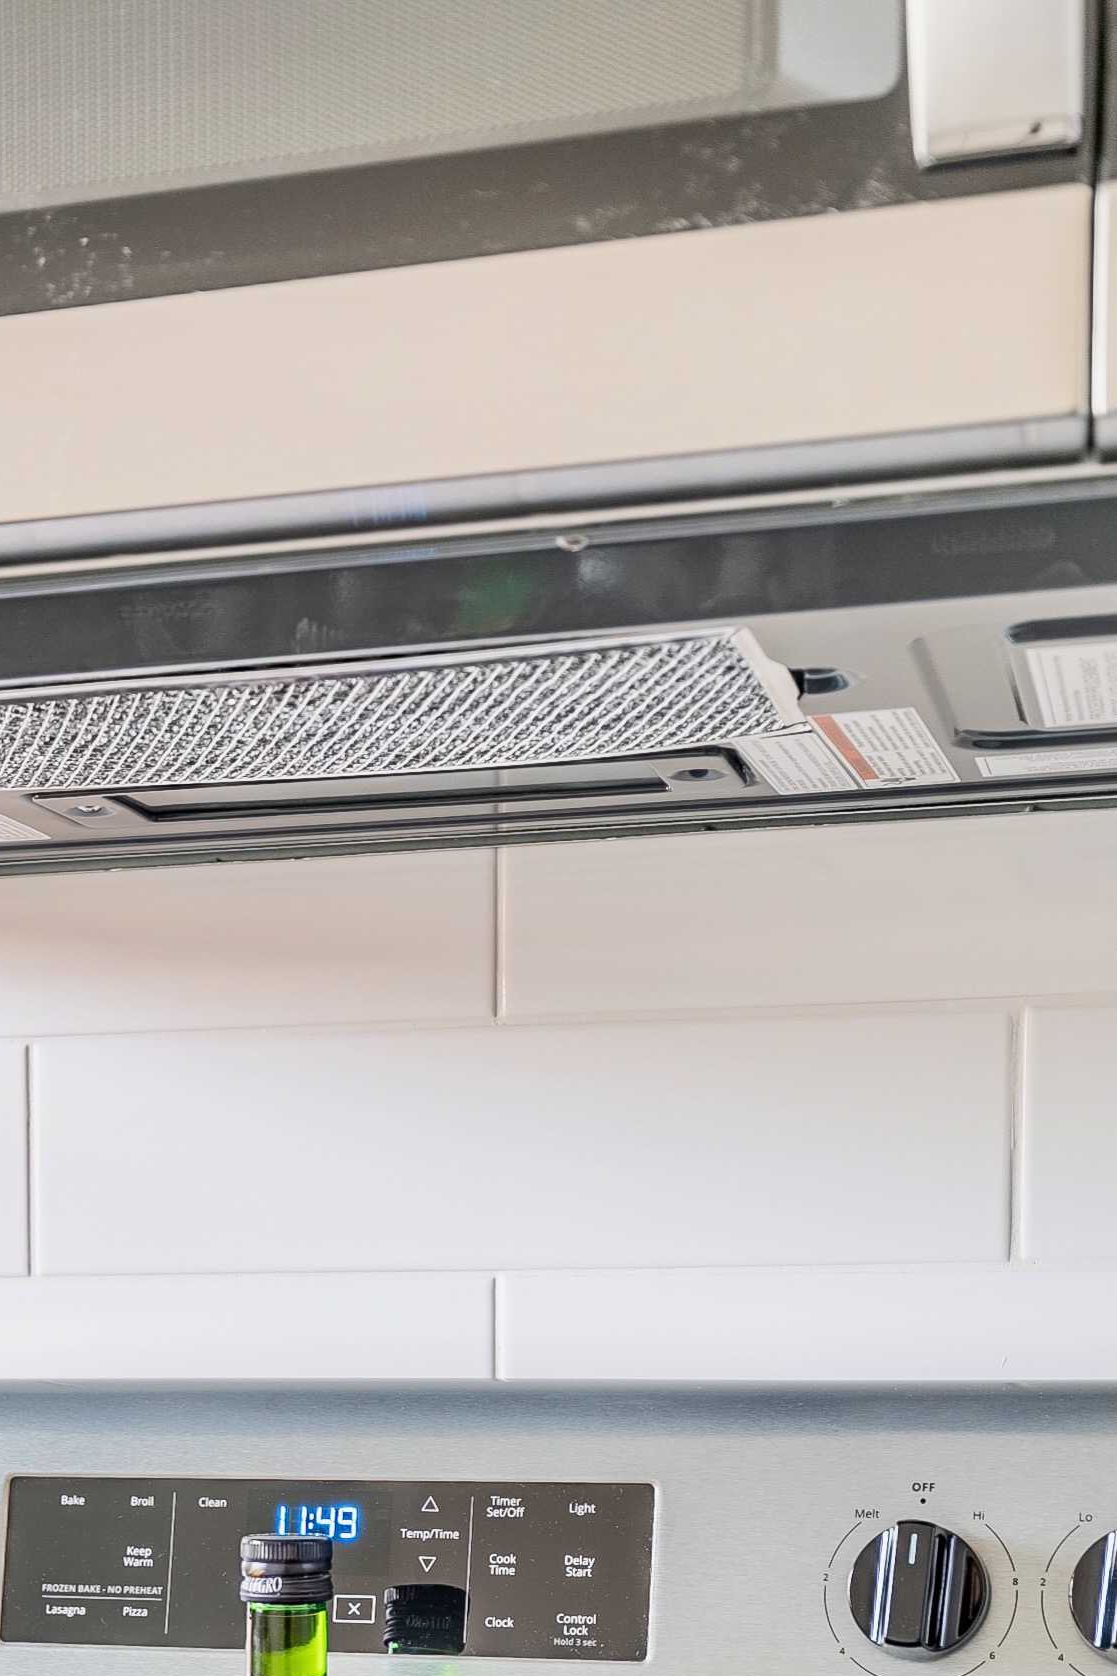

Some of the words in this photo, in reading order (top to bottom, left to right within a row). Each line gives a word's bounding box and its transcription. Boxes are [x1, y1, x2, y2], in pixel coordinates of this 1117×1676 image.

[911, 1482, 935, 1492] OFF
[61, 1495, 86, 1506] Bake
[130, 1496, 154, 1507] Broil
[198, 1497, 227, 1508] Clean
[490, 1495, 522, 1507] Timer
[486, 1506, 525, 1518] Set/Off
[569, 1503, 596, 1516] Light
[855, 1509, 880, 1519] Melt
[973, 1511, 985, 1521] Hi
[1079, 1512, 1093, 1522] Lo
[279, 1506, 358, 1539] 11:49
[400, 1528, 460, 1541] Temp/Time
[126, 1546, 152, 1558] Keep
[123, 1557, 154, 1567] Warm
[489, 1553, 517, 1564] Cook
[564, 1555, 595, 1568] Delay
[489, 1564, 516, 1576] Time
[565, 1566, 593, 1578] Start
[823, 1573, 829, 1581] 2
[1012, 1577, 1019, 1586] 8
[1040, 1577, 1046, 1586] 2
[42, 1583, 76, 1593] FROZEN
[77, 1584, 101, 1593] BAKE
[107, 1585, 122, 1594] NO
[123, 1586, 163, 1595] PREHEAT
[46, 1604, 86, 1617] Lasagna
[122, 1606, 148, 1617] Pizza
[484, 1616, 514, 1628] Clock
[556, 1613, 597, 1625] Control
[563, 1624, 588, 1636] Lock
[553, 1637, 574, 1646] Hold
[575, 1638, 581, 1646] 3
[582, 1639, 597, 1647] sec
[839, 1647, 846, 1655] 4
[989, 1652, 996, 1660] 6
[1057, 1653, 1064, 1661] 4
